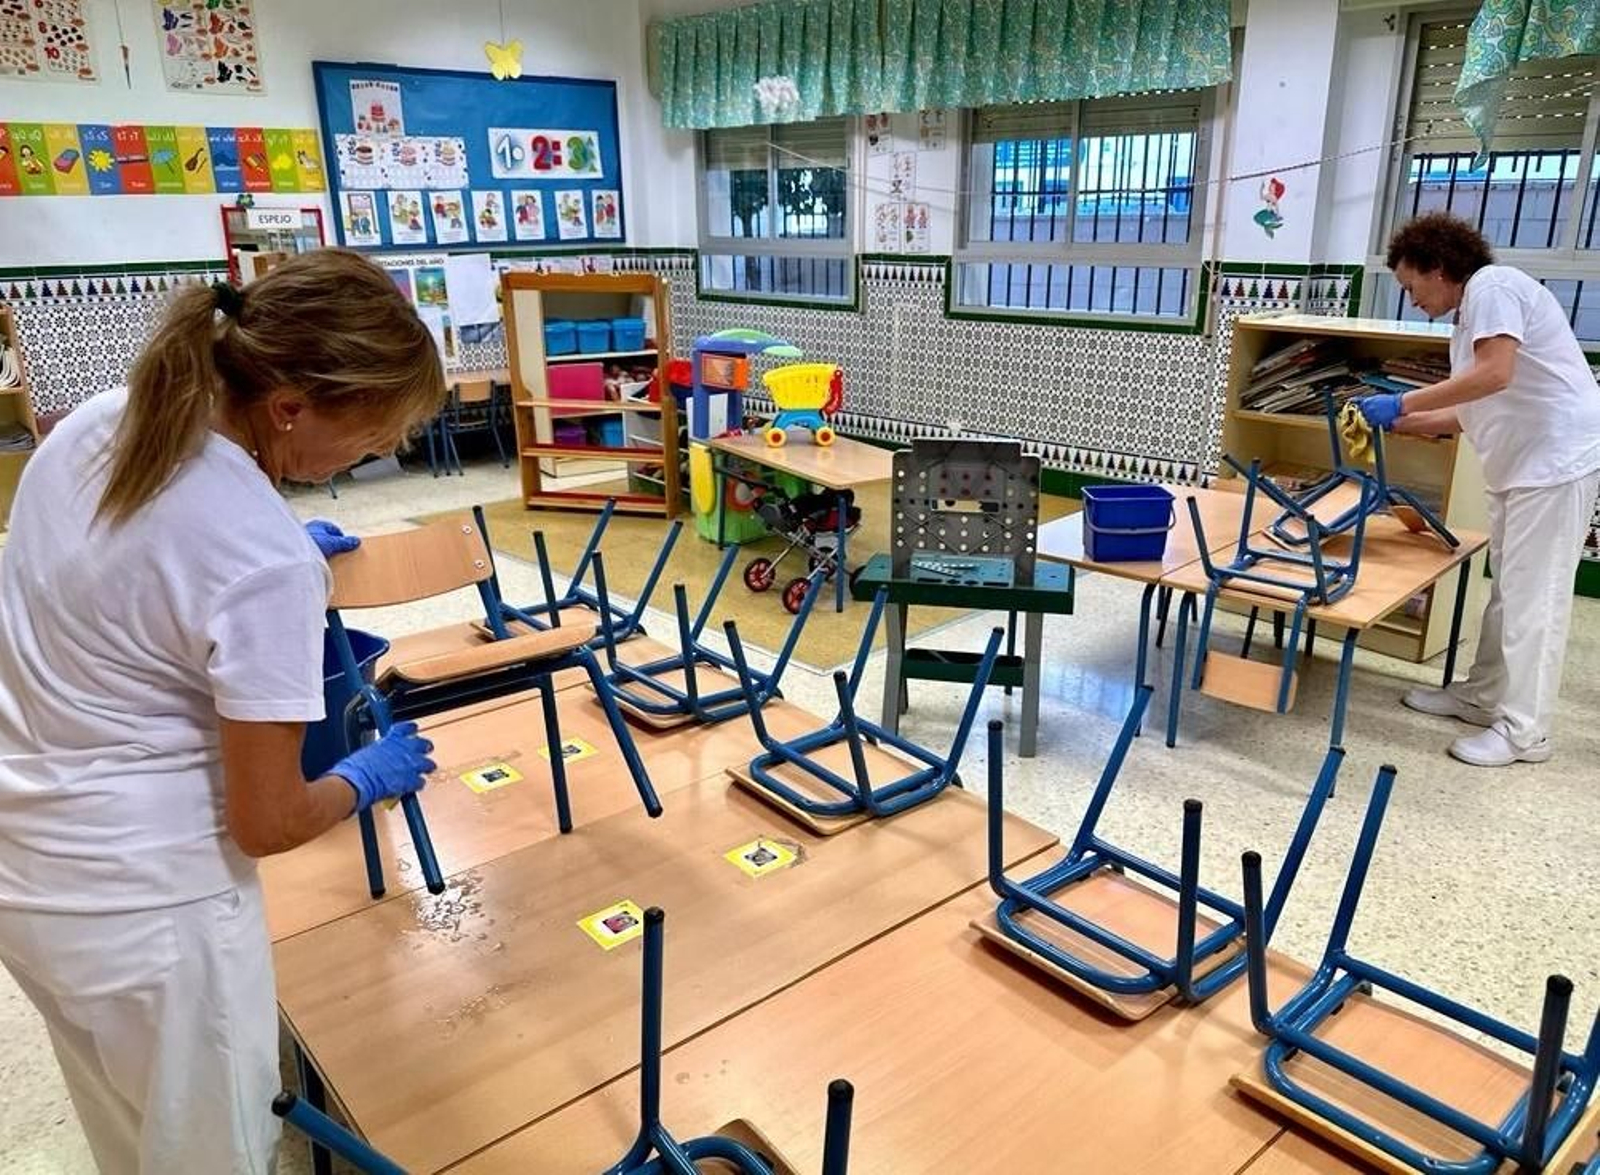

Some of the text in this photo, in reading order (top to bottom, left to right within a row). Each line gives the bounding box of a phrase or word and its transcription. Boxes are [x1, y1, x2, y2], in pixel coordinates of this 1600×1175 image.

[44, 46, 60, 60] 10
[497, 133, 588, 171] 1 2 3
[258, 215, 292, 224] ESPEJO
[416, 258, 428, 266] DEL
